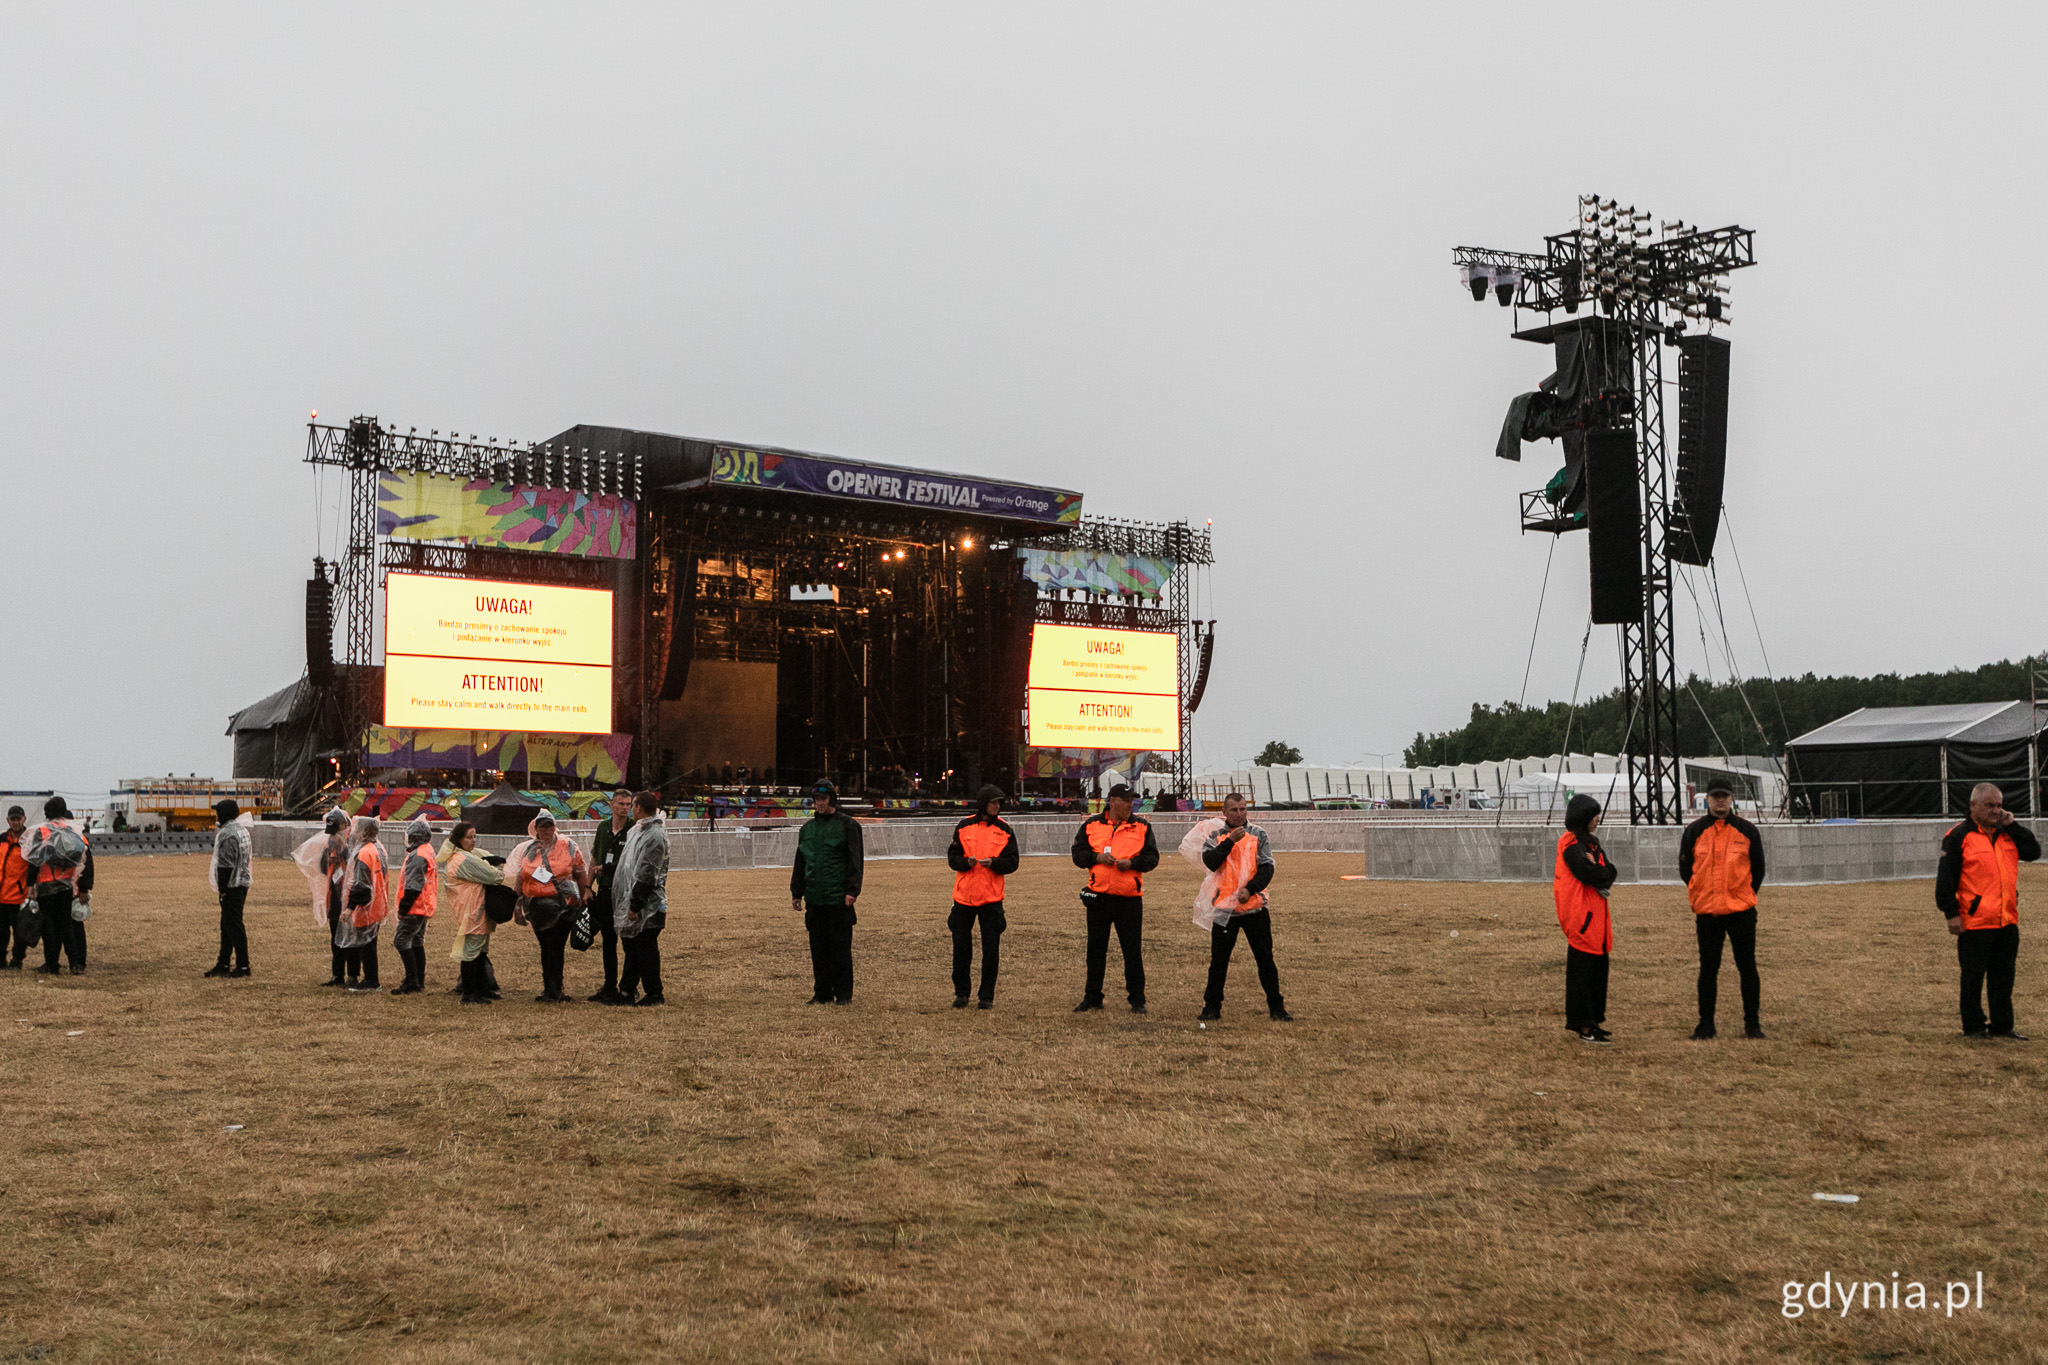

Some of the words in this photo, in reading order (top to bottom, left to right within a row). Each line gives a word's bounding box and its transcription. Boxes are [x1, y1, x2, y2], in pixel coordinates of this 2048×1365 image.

[826, 469, 902, 499] OPEN'ER
[906, 480, 980, 508] FESTIVAL
[982, 494, 1005, 503] Powered
[1006, 497, 1014, 505] by
[1015, 495, 1049, 511] Orange
[476, 596, 532, 615] UWAGA!
[438, 619, 463, 628] Bardzo
[464, 622, 492, 631] prosimy
[500, 624, 540, 633] zachowanie
[541, 628, 567, 636] spokoju
[456, 634, 492, 642] podążanie
[501, 636, 531, 645] kierunku
[1087, 640, 1124, 654] UWAGA!
[462, 674, 543, 692] ATTENTION!
[411, 697, 436, 707] Please
[437, 698, 452, 708] stay
[454, 699, 472, 708] calm
[474, 700, 487, 708] and
[488, 701, 504, 709] walk
[506, 701, 531, 711] directly
[542, 703, 552, 712] the
[554, 704, 571, 712] main
[572, 705, 588, 713] exits
[1079, 704, 1133, 717] ATTENTION!
[1046, 722, 1062, 730] Please
[1063, 723, 1073, 731] stay
[527, 737, 553, 745] ALTER
